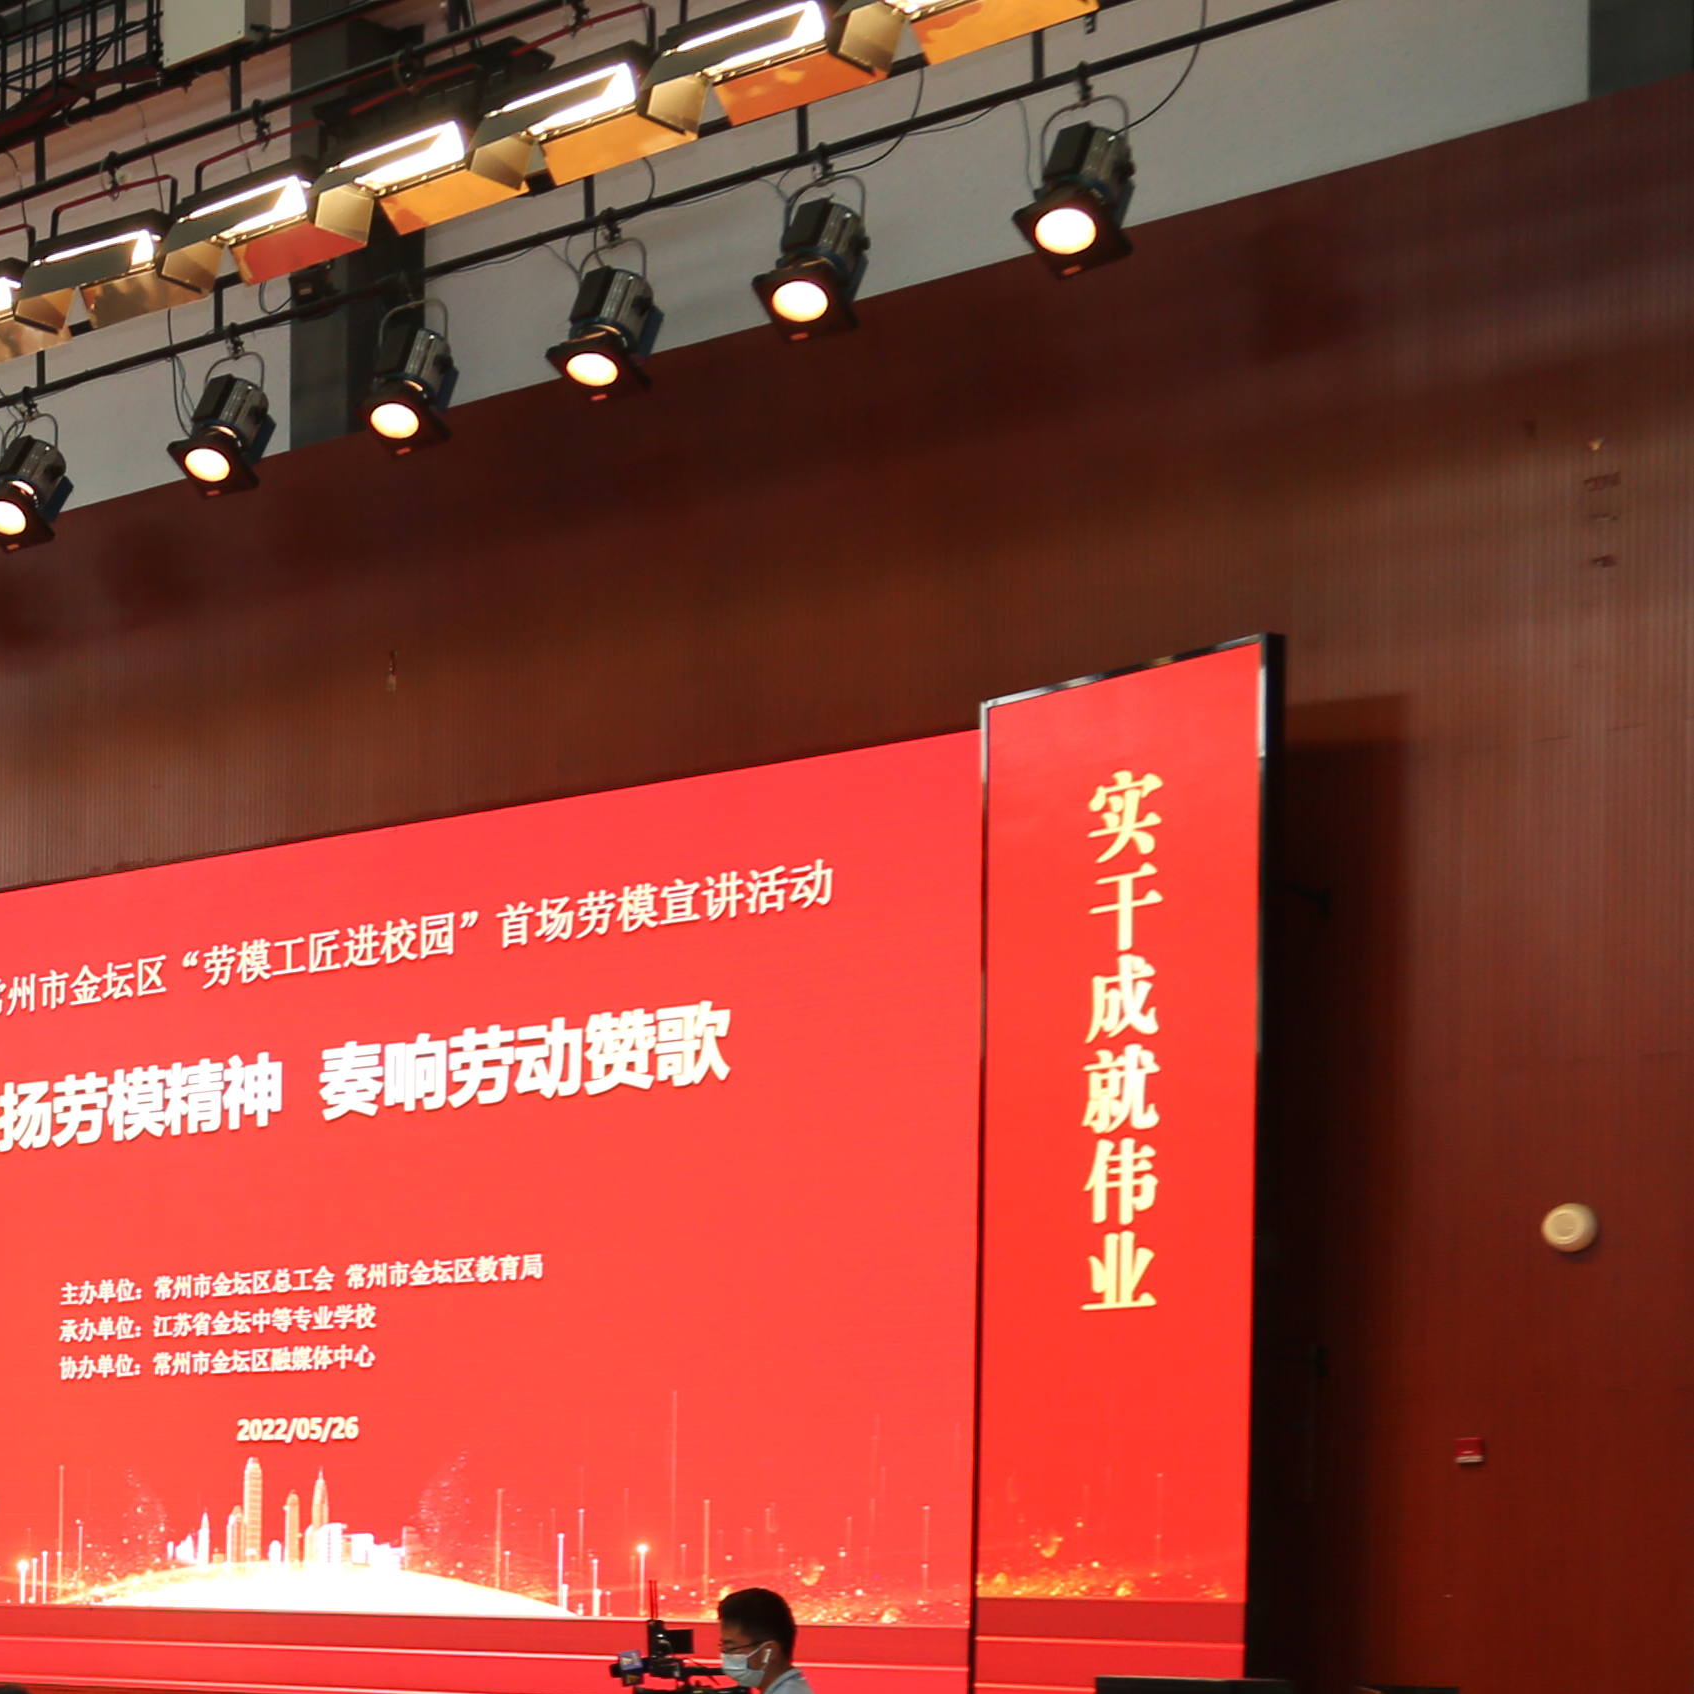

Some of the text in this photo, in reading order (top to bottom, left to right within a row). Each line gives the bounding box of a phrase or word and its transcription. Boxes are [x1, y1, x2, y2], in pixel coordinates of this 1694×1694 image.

[318, 1001, 732, 1121] 奏响劳动赞歌
[1081, 770, 1165, 1312] 实干成就伟业
[236, 1415, 361, 1445] 2022/05/26
